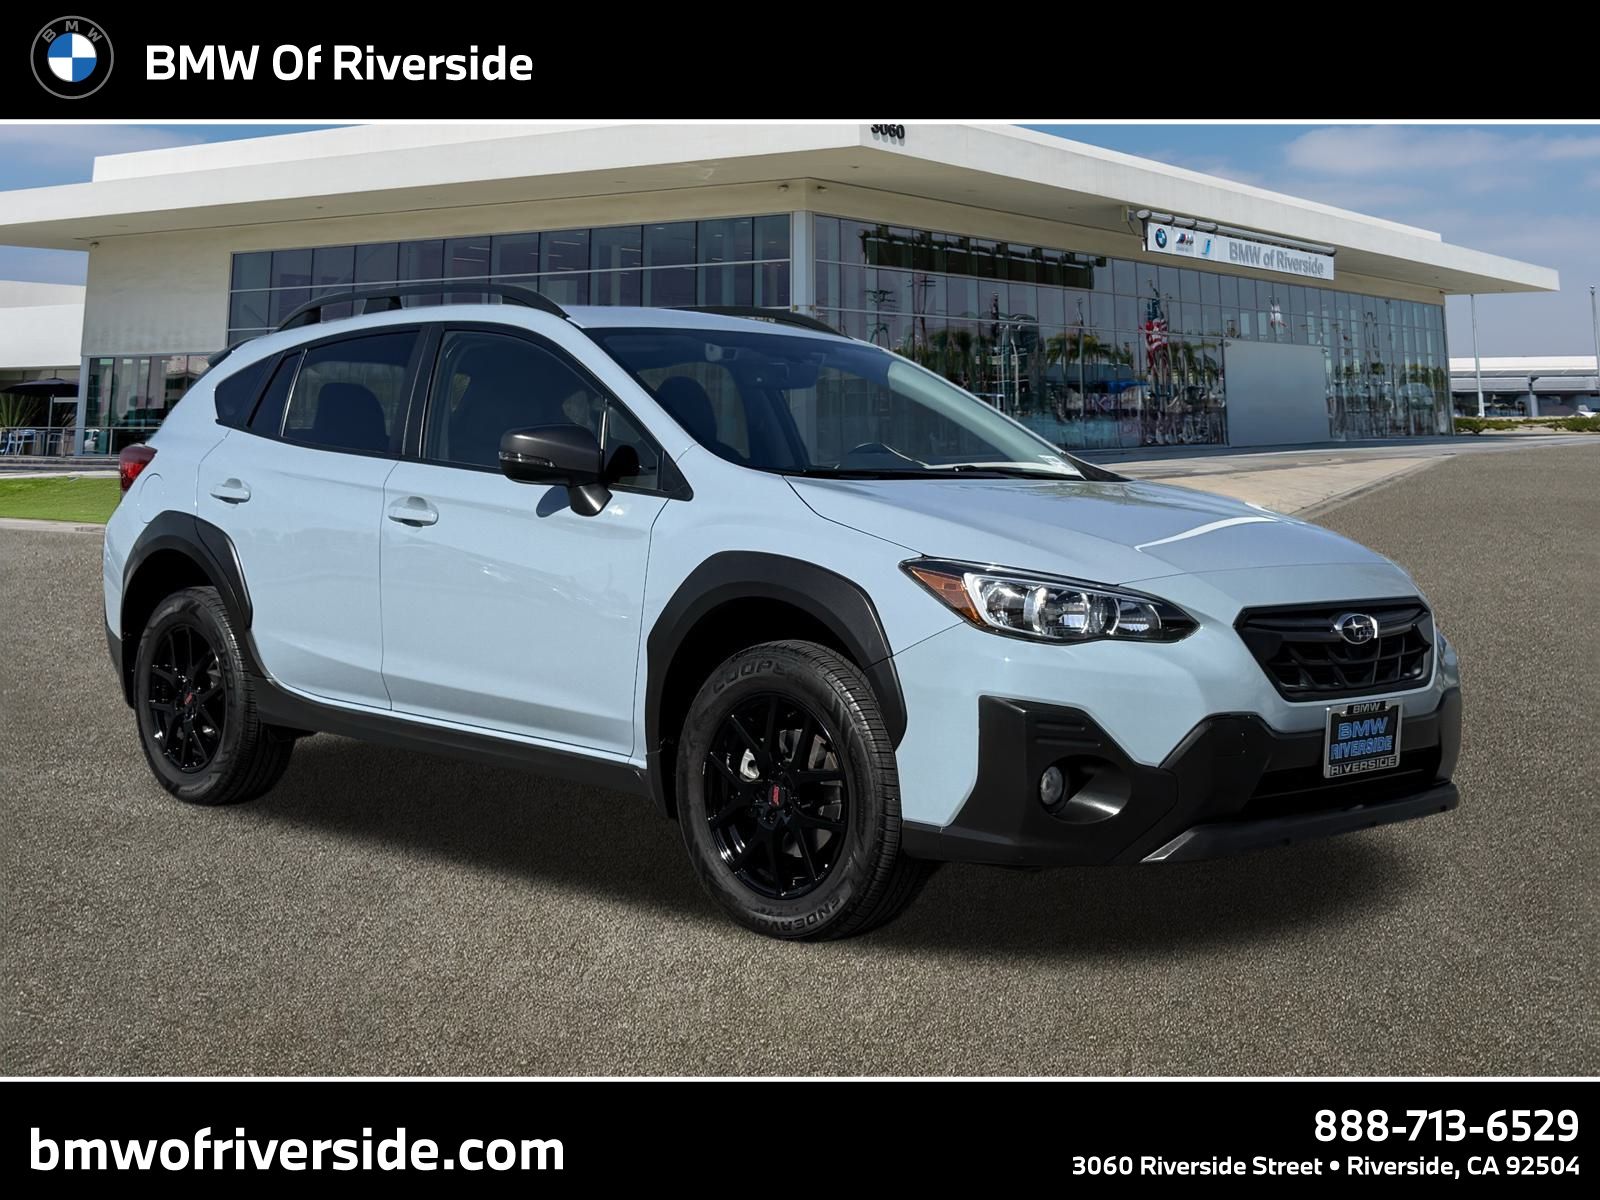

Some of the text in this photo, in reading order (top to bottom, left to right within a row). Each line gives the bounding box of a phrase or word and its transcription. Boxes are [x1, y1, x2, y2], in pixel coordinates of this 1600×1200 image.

[1229, 241, 1261, 266] BMW
[1263, 250, 1274, 267] of
[1276, 251, 1325, 276] Riverside
[1352, 702, 1381, 714] BMW
[1338, 716, 1389, 740] BMW
[1330, 735, 1393, 760] RIVERSIDE
[1330, 756, 1396, 776] RIVERSIDE
